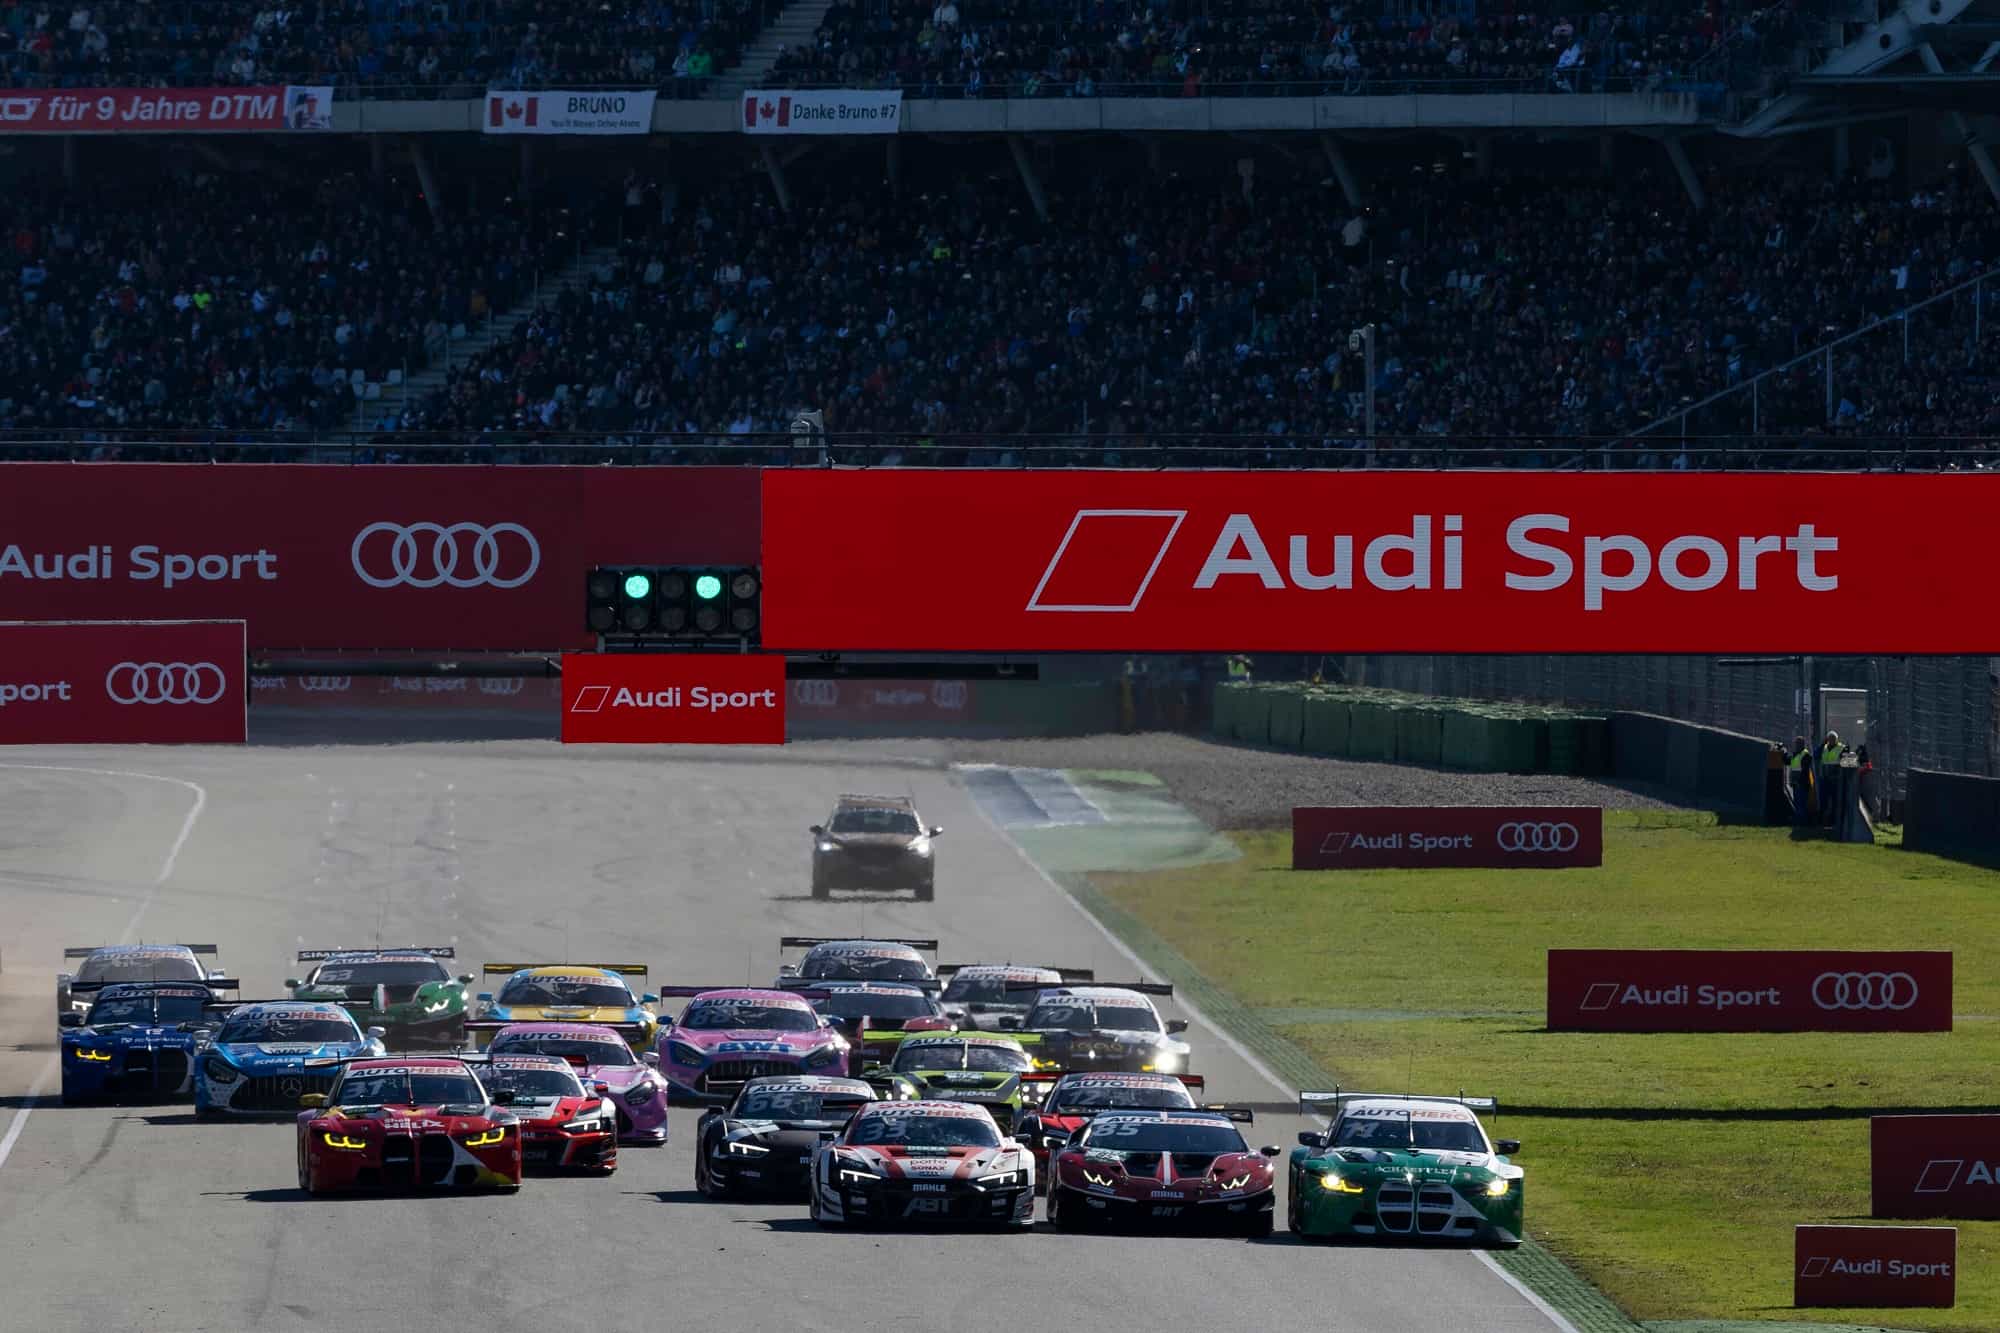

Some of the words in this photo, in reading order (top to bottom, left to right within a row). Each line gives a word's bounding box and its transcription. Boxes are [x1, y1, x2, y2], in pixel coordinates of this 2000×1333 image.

[48, 97, 91, 121] für
[96, 96, 115, 121] 9
[121, 97, 201, 121] Jahre
[209, 95, 277, 120] DTM
[568, 97, 625, 113] BRUNO
[793, 104, 835, 120] Danke
[838, 104, 877, 120] Bruno
[880, 104, 897, 119] #7
[0, 544, 112, 580] Audi
[128, 545, 278, 589] Sport
[1193, 511, 1463, 591] Audi
[1503, 513, 1840, 612] Sport
[611, 686, 682, 708] Audi
[690, 686, 776, 713] Sport
[1350, 832, 1403, 849] Audi
[1408, 832, 1473, 853] Sport
[1620, 983, 1689, 1005] Audi
[1697, 984, 1781, 1011] Sport
[239, 1011, 341, 1022] AUTOHERO
[352, 1066, 465, 1077] AUTOHERO
[1351, 1108, 1468, 1120] AUTOHERO
[1093, 1123, 1140, 1137] 85
[1831, 1258, 1882, 1275] Audi
[1887, 1258, 1951, 1279] Sport
